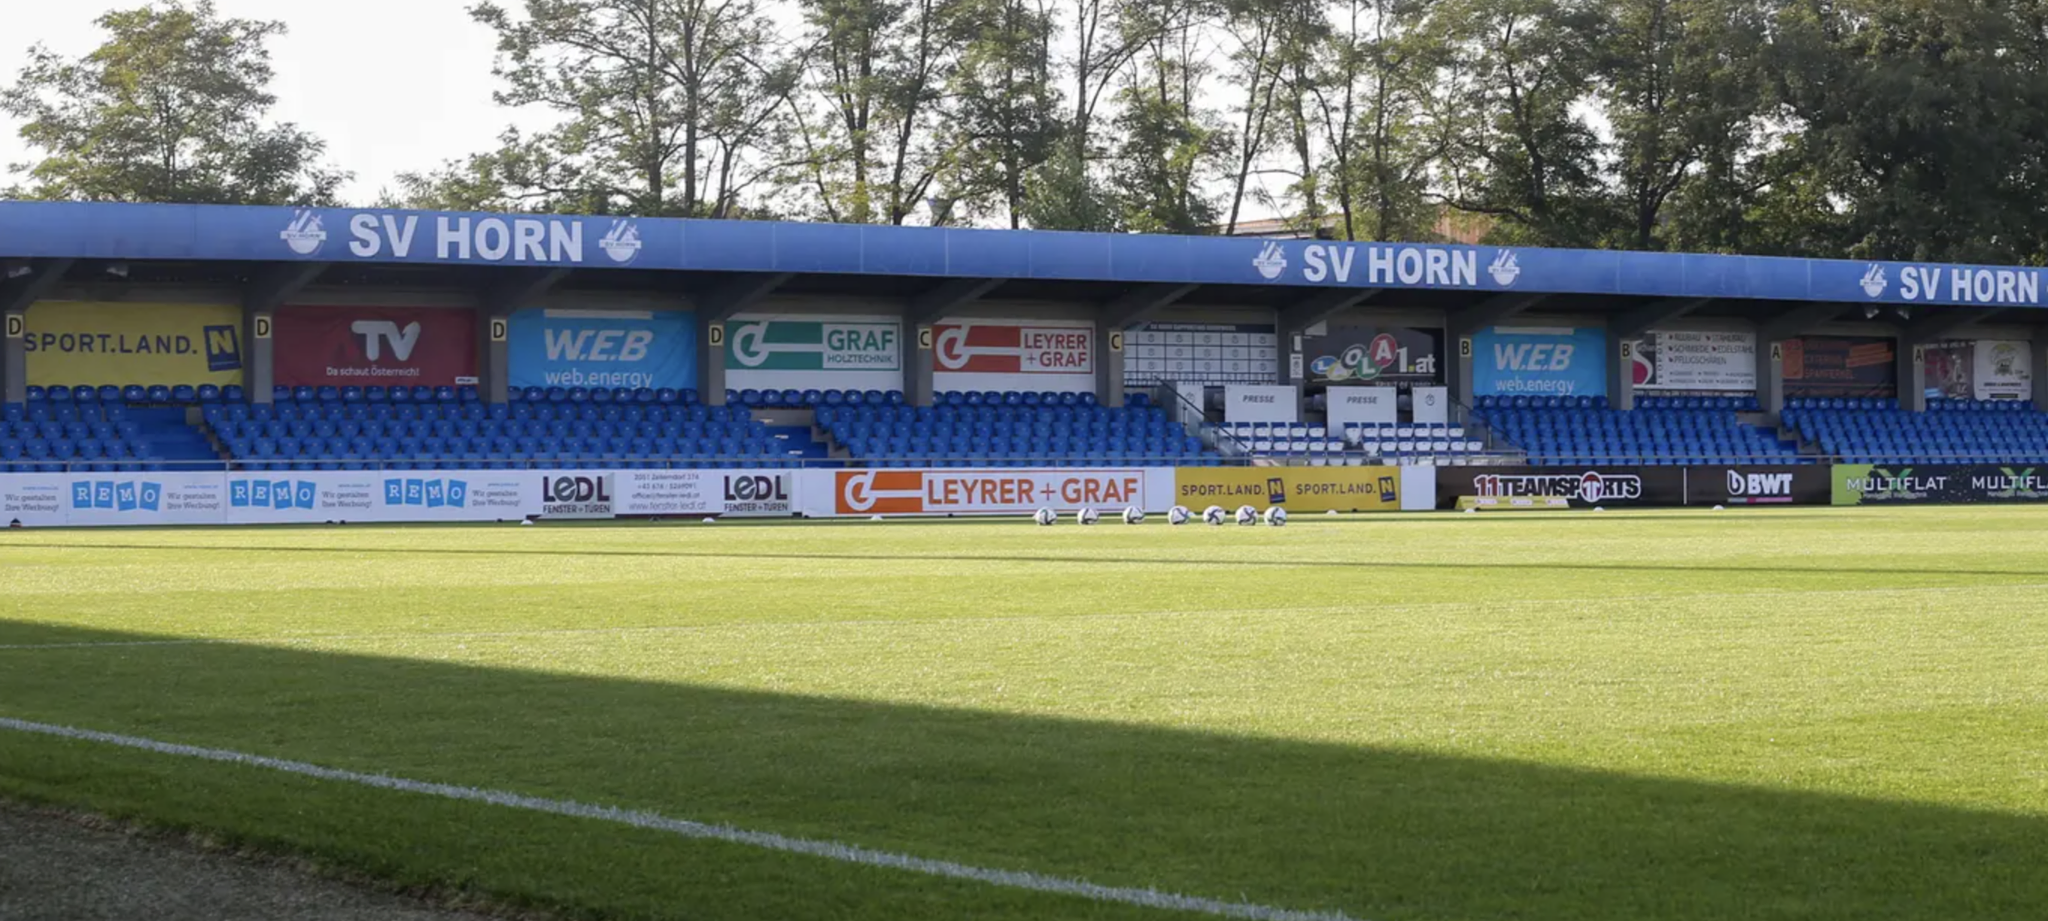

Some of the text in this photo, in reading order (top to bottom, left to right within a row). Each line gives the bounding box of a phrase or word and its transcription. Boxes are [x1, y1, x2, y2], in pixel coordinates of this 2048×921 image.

[349, 213, 584, 262] SV HORN
[1303, 244, 1477, 286] SV HORN
[1900, 266, 2039, 304] SV HORN
[8, 316, 21, 335] D
[256, 318, 269, 336] D
[492, 321, 505, 338] D
[24, 331, 198, 354] SPORT.LAND.
[711, 327, 722, 343] D
[827, 330, 894, 351] GRAF
[919, 330, 929, 346] C
[1024, 333, 1087, 350] LEYRER
[1111, 333, 1120, 349] C
[544, 328, 654, 361] W.E.B
[1461, 340, 1470, 355] B
[1622, 343, 1630, 357] B
[1771, 345, 1781, 359] A
[827, 354, 894, 364] HOLZTECHNIK
[1039, 351, 1087, 367] GRAF
[1494, 343, 1574, 371] W.E.B
[1915, 348, 1923, 362] A
[326, 363, 420, 376] Da schaut Österreich!
[545, 368, 653, 390] web.energy
[1496, 376, 1575, 395] web.energy
[1243, 394, 1275, 403] PRESSE
[1346, 396, 1378, 405] PRESSE
[1181, 484, 1265, 496] SPORT.LAND.
[1296, 483, 1377, 495] SPORT.LAND.
[1747, 473, 1793, 494] BWT
[1846, 476, 1947, 491] MULTIFLAT
[1972, 475, 2048, 490] MULTIFL
[75, 486, 157, 504] REMO
[233, 485, 312, 502] REMO
[387, 484, 463, 501] REMO
[927, 479, 1034, 505] LEYRER
[1061, 478, 1138, 504] GRAF
[543, 505, 577, 514] FENSTER
[585, 504, 610, 513] TÜREN
[724, 503, 757, 512] FENSTER
[764, 502, 788, 511] TÜREN
